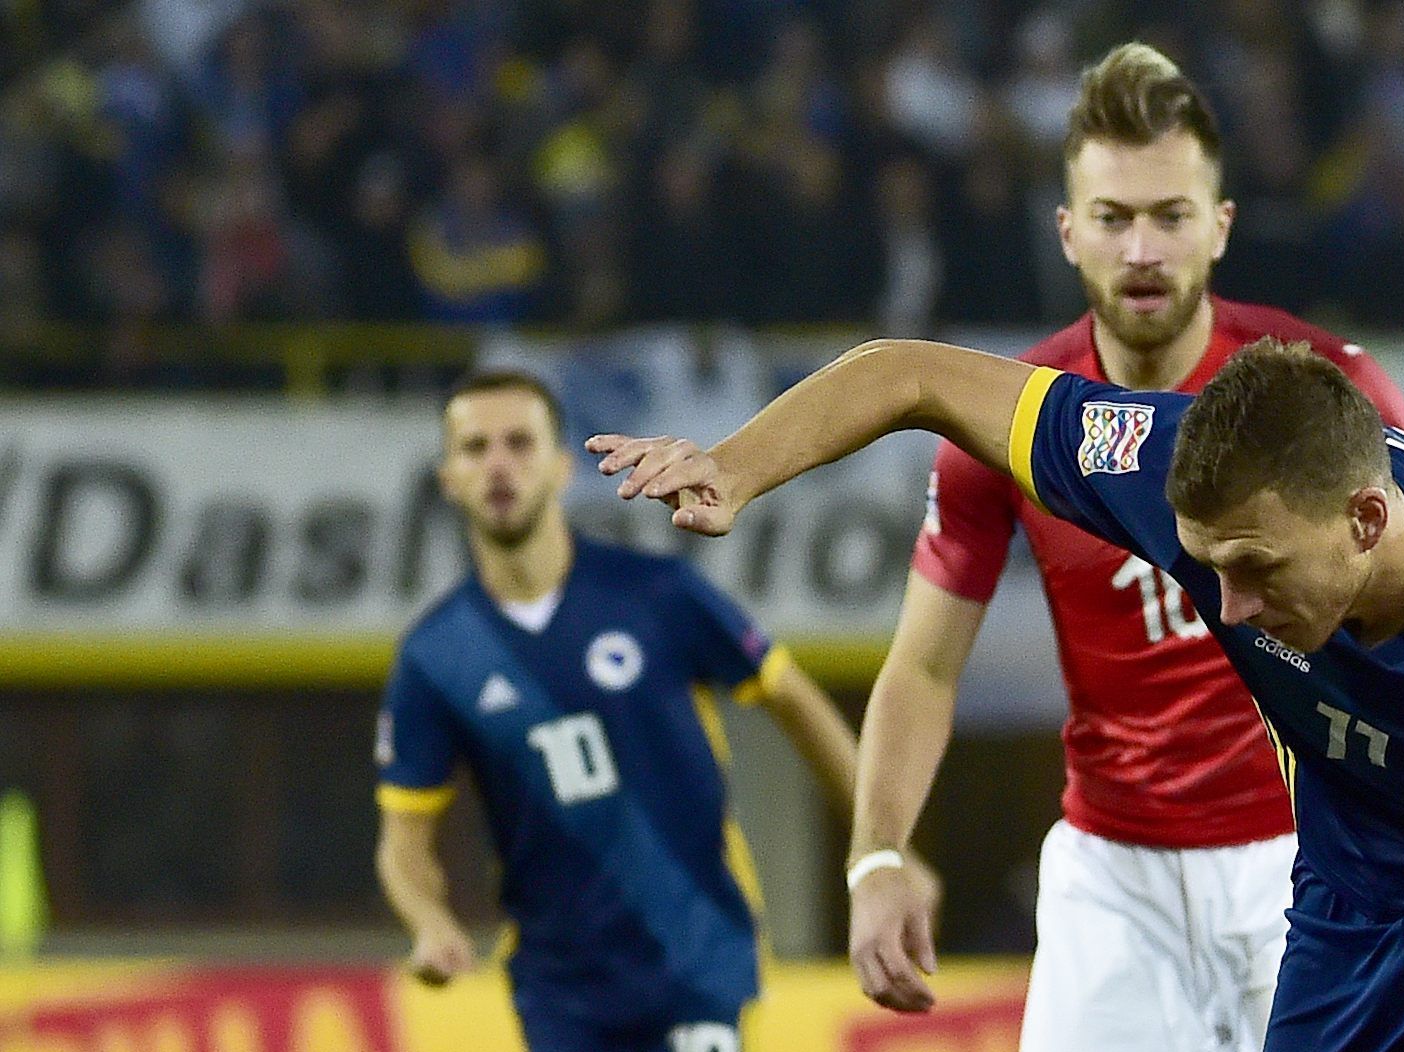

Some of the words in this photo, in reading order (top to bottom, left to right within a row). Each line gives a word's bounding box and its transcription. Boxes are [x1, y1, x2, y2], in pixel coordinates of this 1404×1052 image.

[1254, 630, 1311, 673] adidas
[526, 711, 620, 807] 10
[1316, 700, 1390, 768] 11
